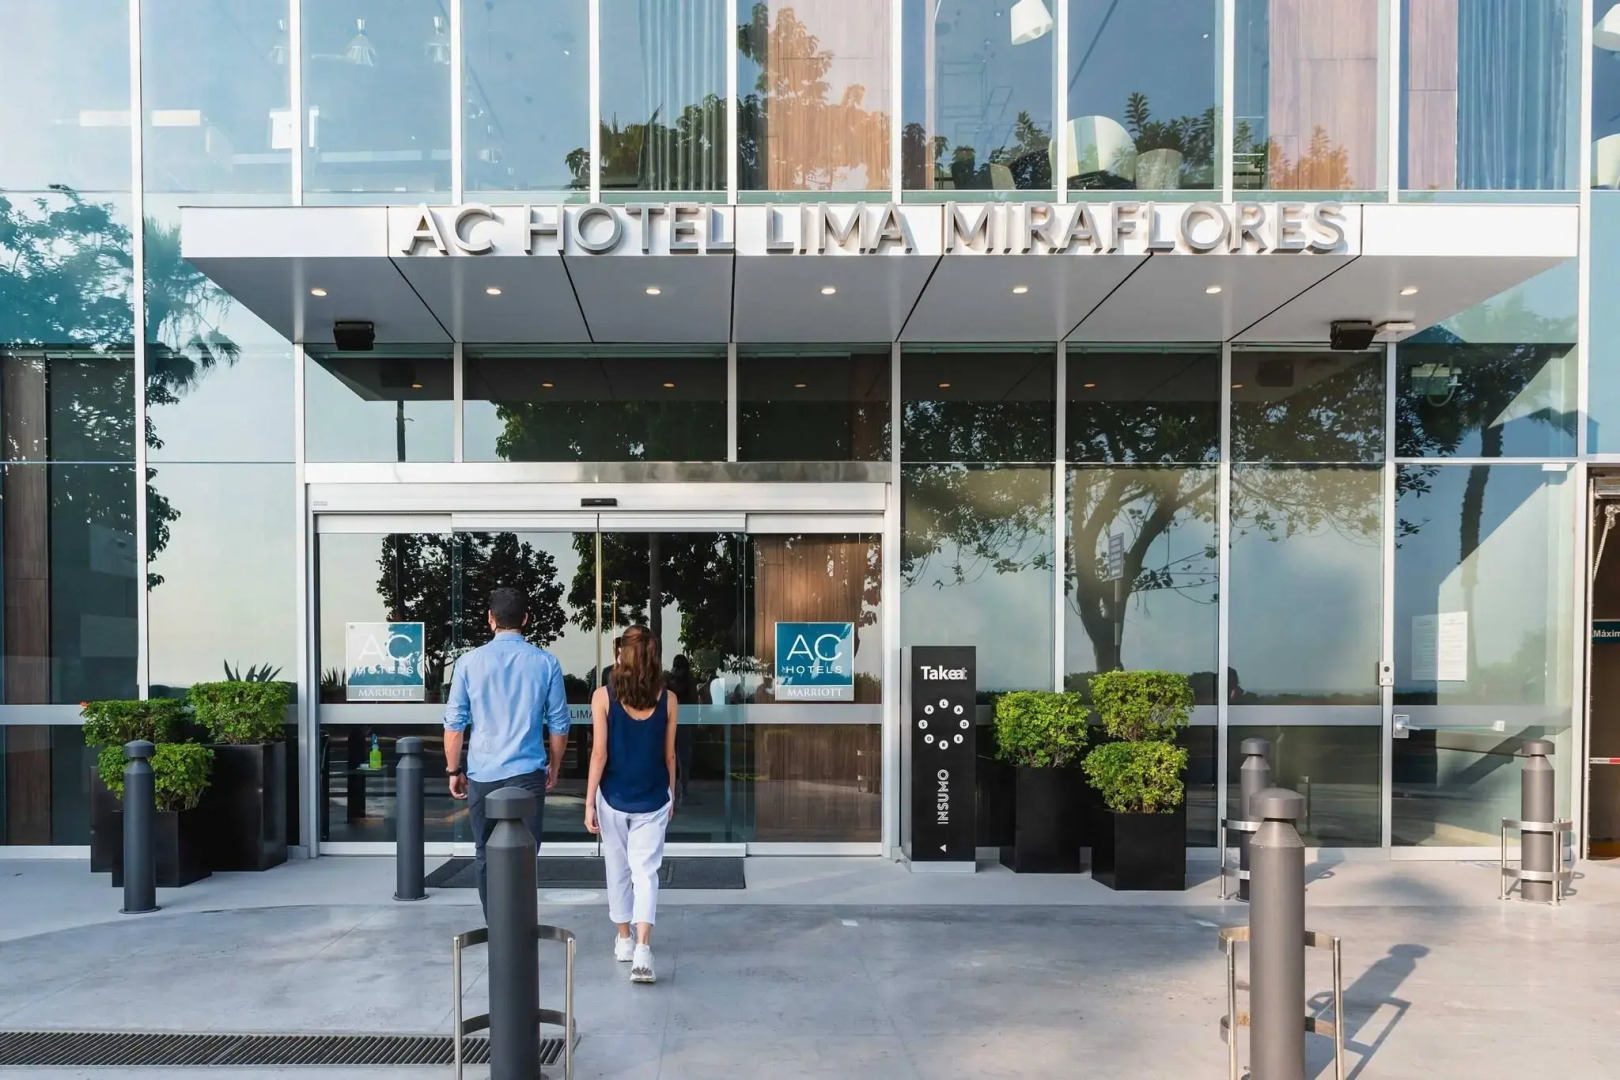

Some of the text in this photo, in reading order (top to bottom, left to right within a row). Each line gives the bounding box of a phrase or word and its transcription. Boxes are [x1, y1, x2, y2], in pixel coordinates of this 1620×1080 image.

[402, 201, 1346, 255] AC HOTEL LIMA MIRAFLORES
[358, 634, 414, 661] AC
[786, 633, 842, 661] AC
[785, 666, 843, 674] HOTELS
[358, 688, 414, 697] MARRIOTT
[787, 688, 843, 697] MARRIOTT
[937, 768, 949, 825] INSUMO
